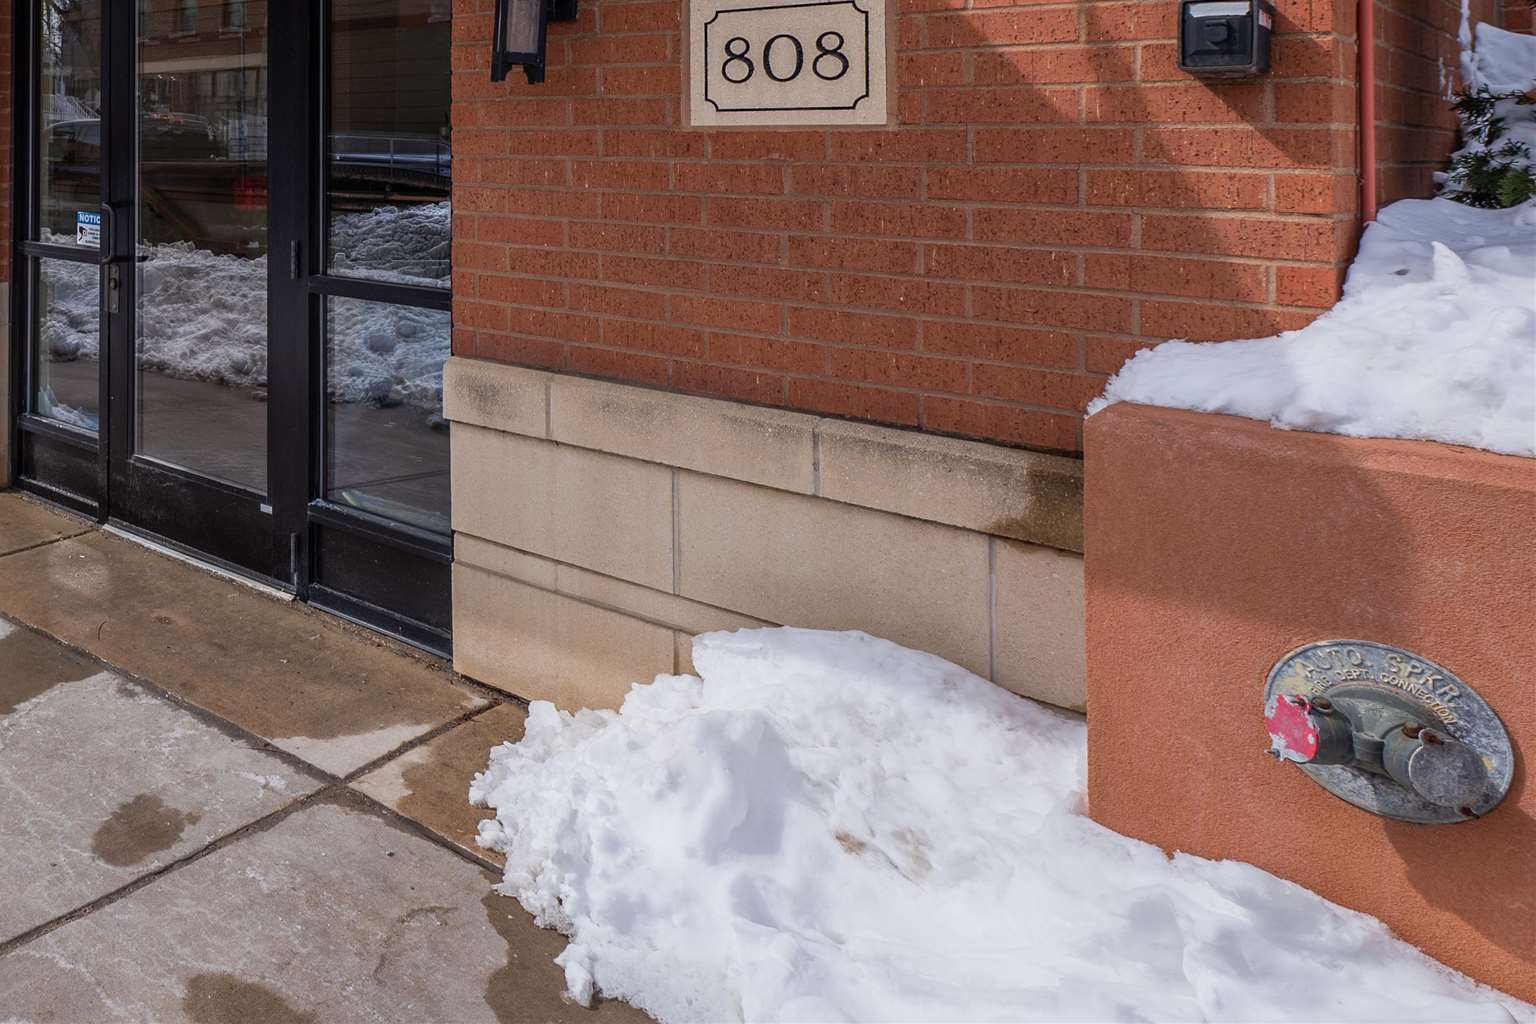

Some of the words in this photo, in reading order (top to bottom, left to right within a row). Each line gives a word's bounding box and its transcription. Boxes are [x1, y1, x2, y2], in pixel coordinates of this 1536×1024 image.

[720, 30, 850, 84] 808
[79, 213, 101, 224] NOTIC
[1379, 672, 1458, 726] CONNECTION
